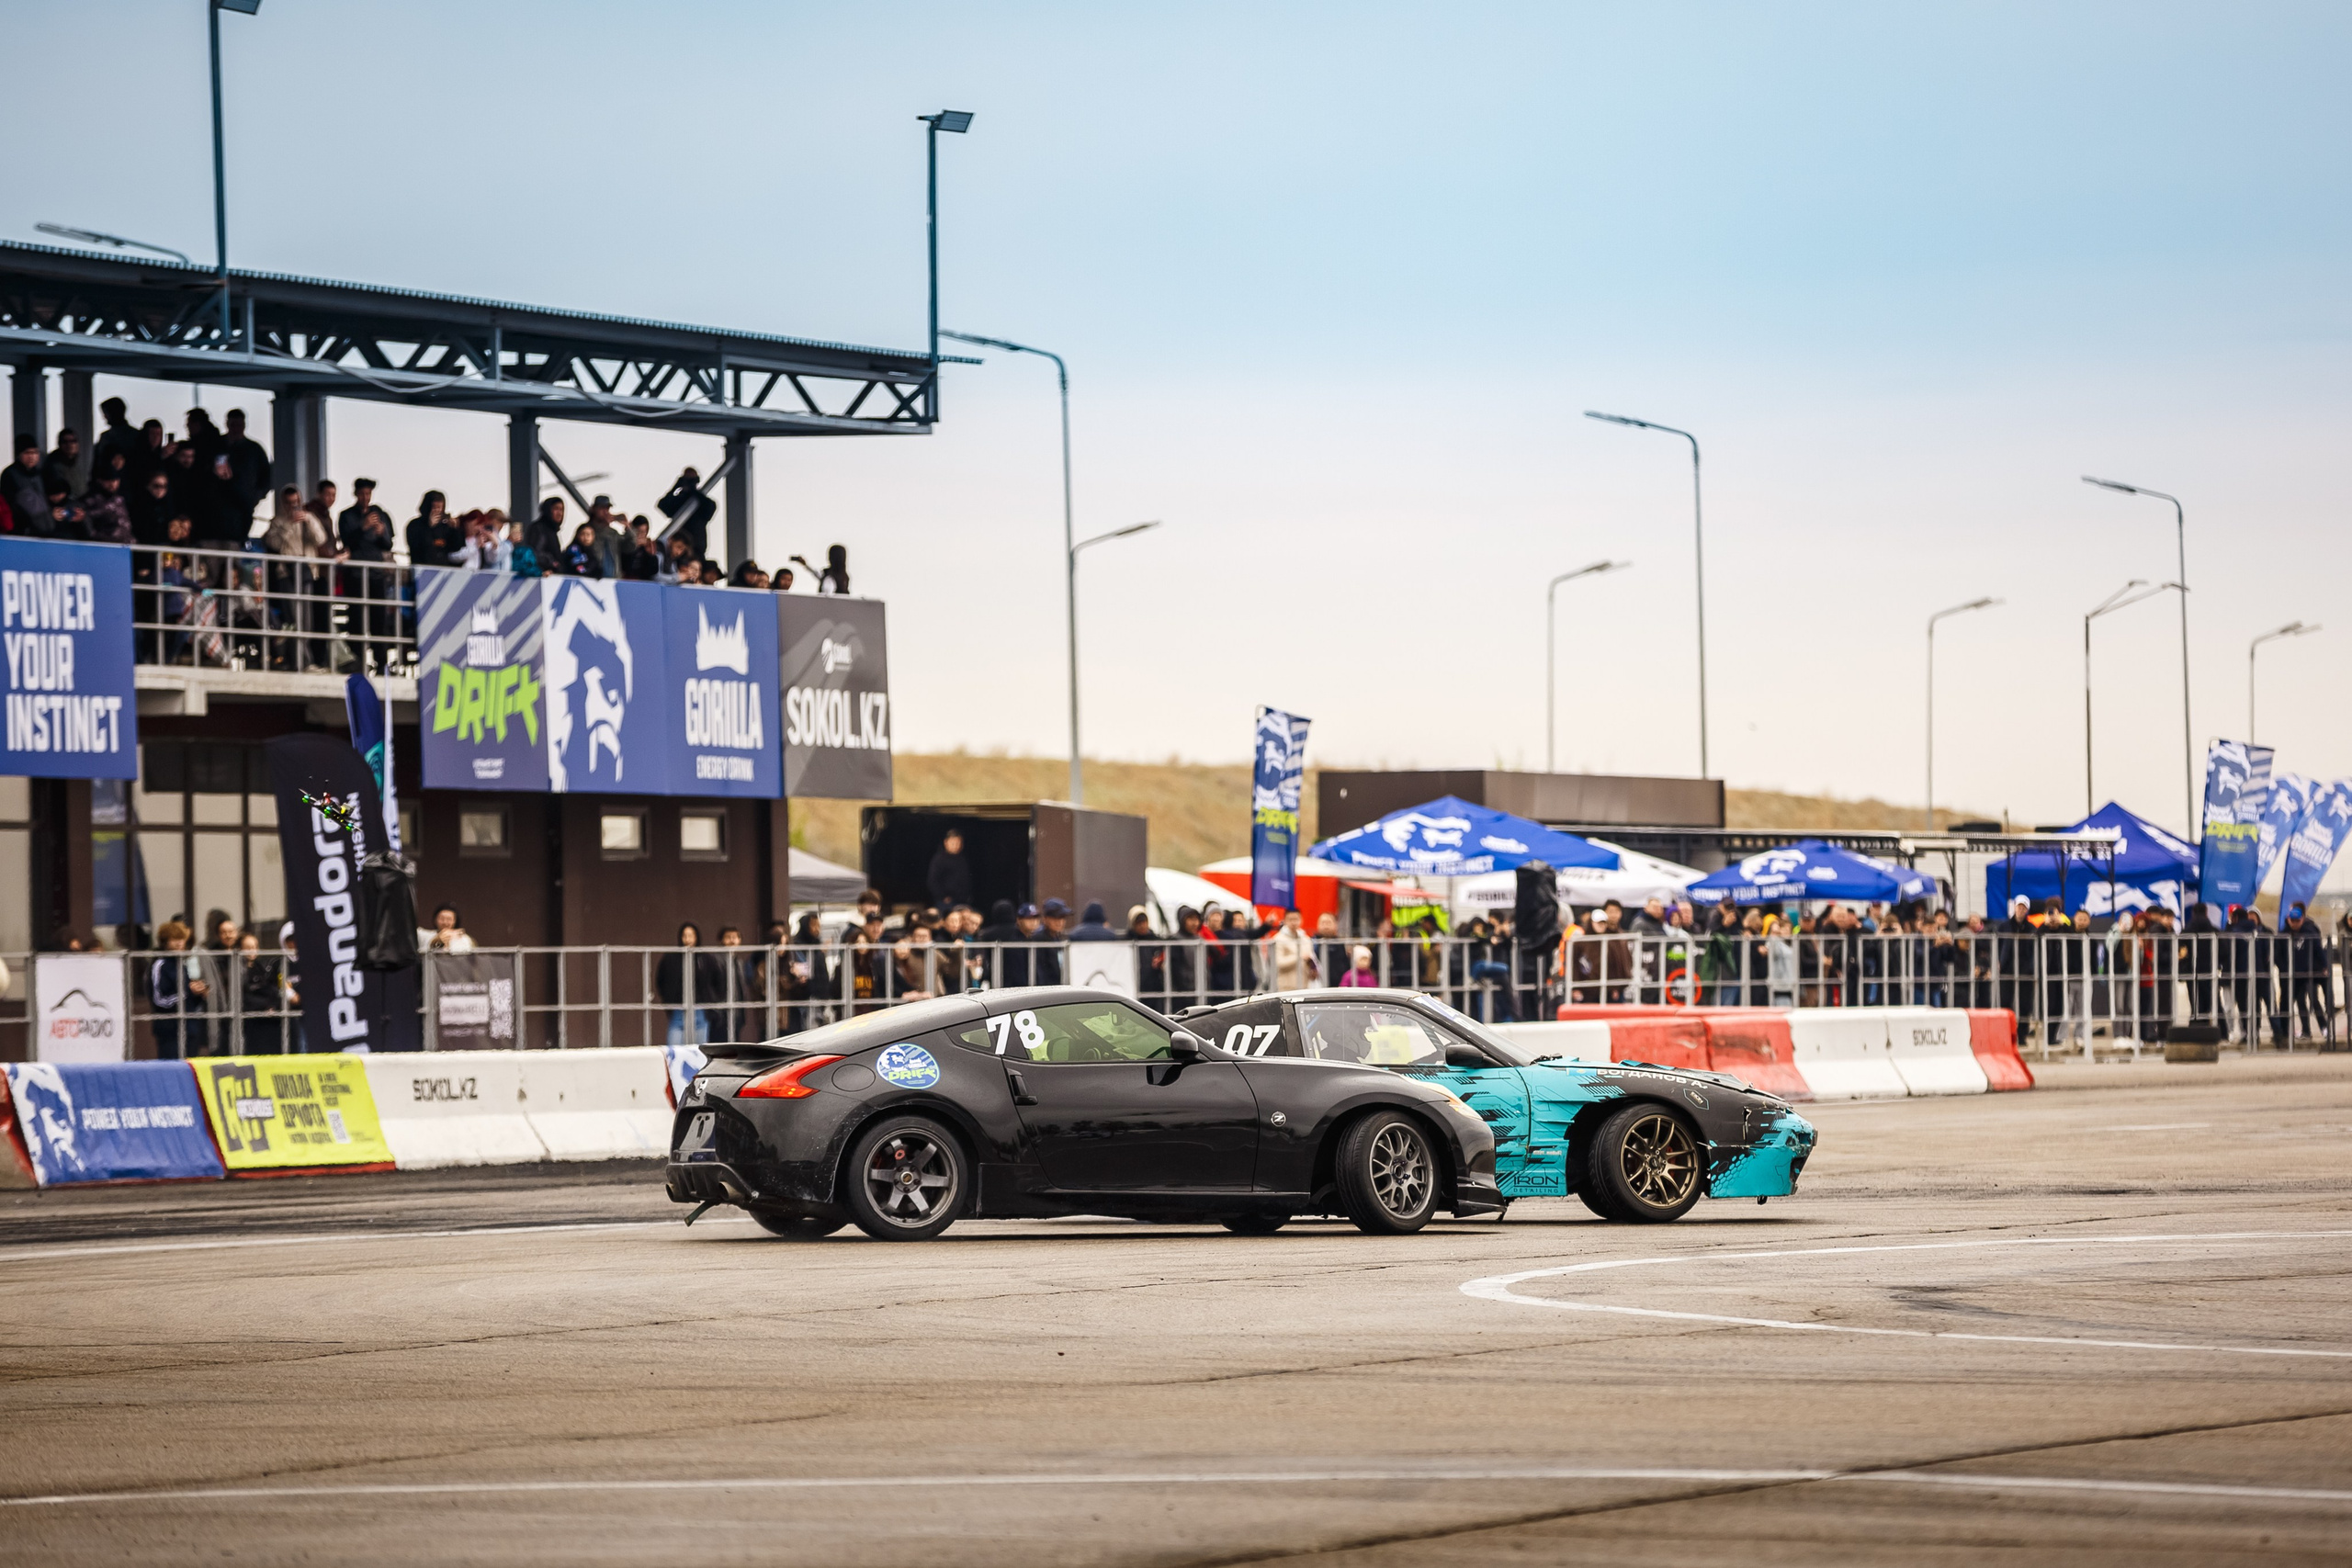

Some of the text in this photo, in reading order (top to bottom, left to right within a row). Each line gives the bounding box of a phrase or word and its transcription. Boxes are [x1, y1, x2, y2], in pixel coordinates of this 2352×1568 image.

[2, 570, 95, 631] POWER
[5, 632, 75, 691] YOUR
[467, 635, 505, 667] GORILLA
[6, 694, 122, 753] INSTINCT
[433, 660, 540, 747] DRIFT
[685, 678, 764, 750] GORILLA
[786, 686, 889, 750] SOKOL.KZ
[696, 755, 728, 780] ENERGY
[2290, 832, 2333, 865] GORILLA
[986, 1010, 1045, 1055] 78
[1222, 1023, 1281, 1056] 07
[1597, 1069, 1687, 1084] БОГДАНОВ
[1513, 1176, 1559, 1186] IRON
